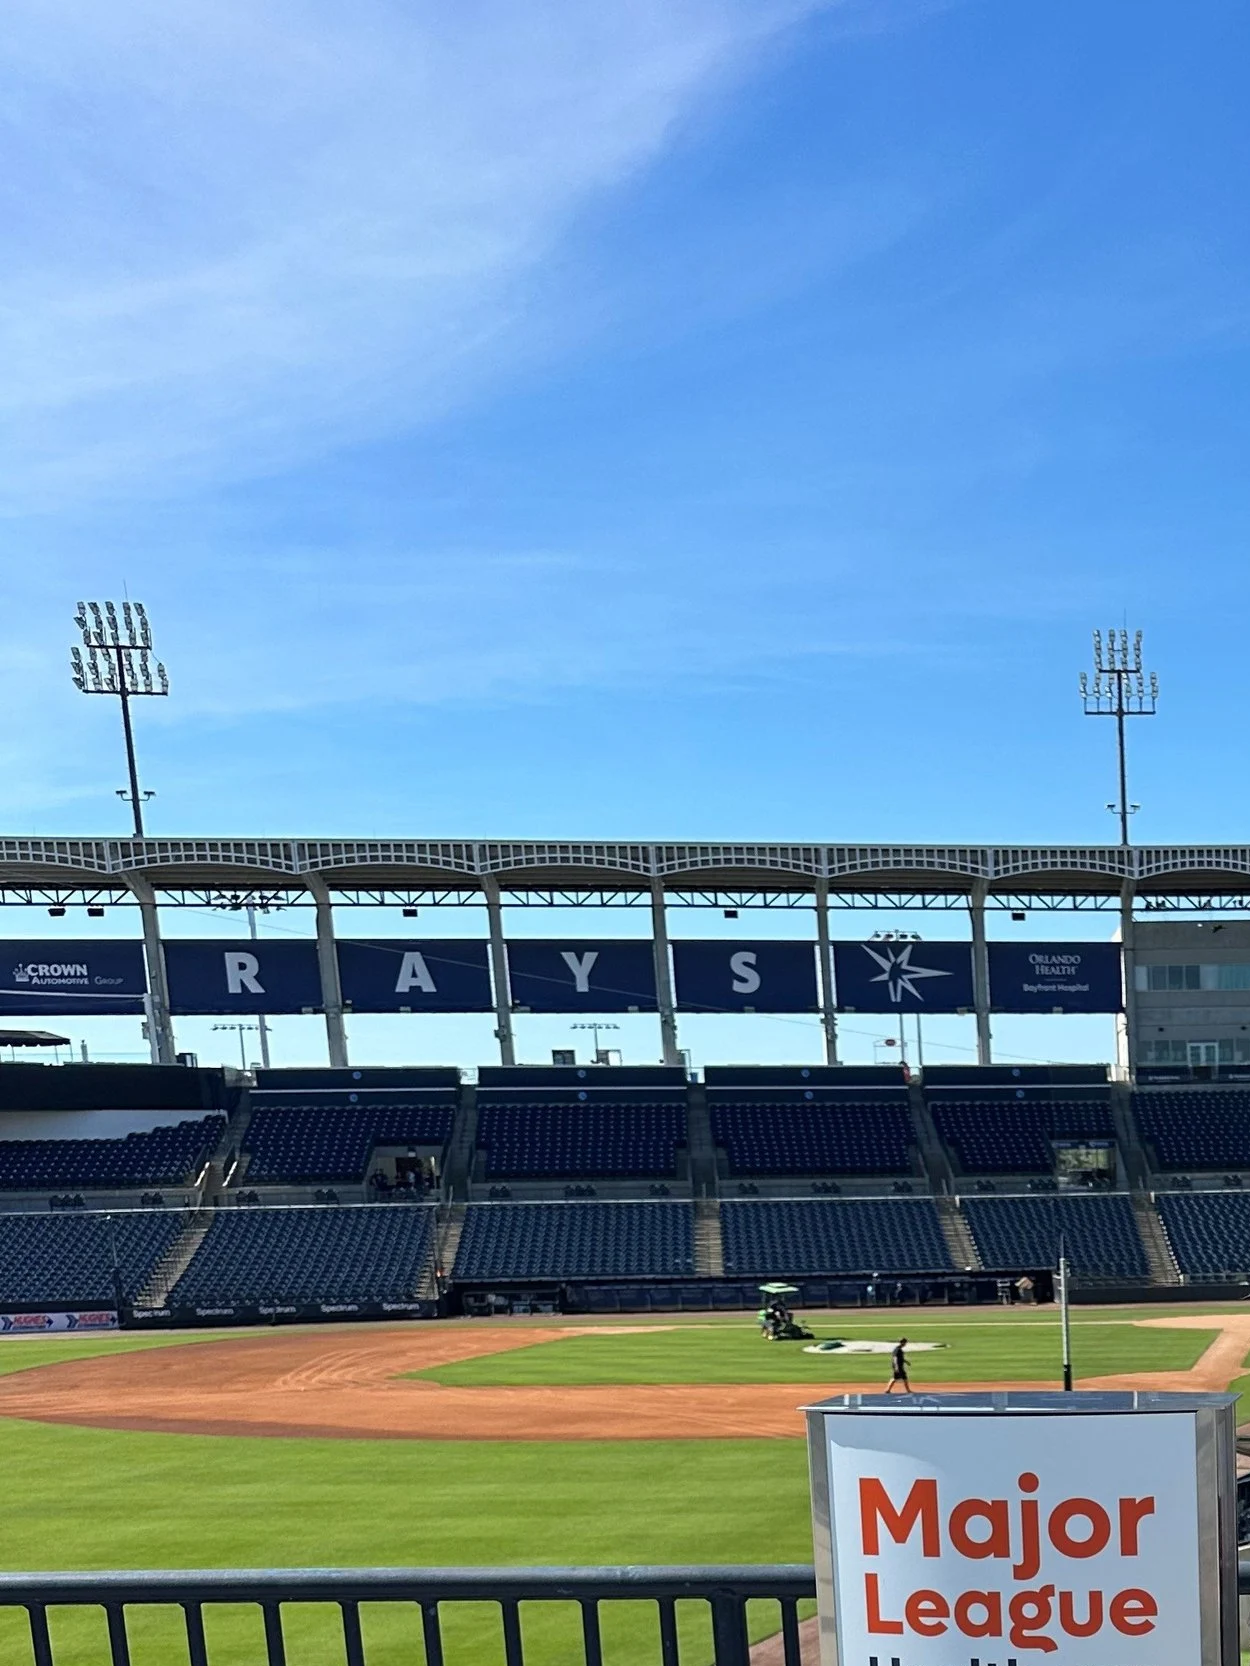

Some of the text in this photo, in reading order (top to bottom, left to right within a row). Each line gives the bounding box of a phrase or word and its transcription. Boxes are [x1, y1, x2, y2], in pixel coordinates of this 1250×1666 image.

[27, 963, 89, 977] CROWN
[224, 951, 762, 995] R A Y S
[1028, 953, 1081, 965] ORLANDO
[32, 976, 90, 985] AUTOMOTIVE
[858, 1471, 1155, 1581] Major
[864, 1572, 1158, 1654] League
